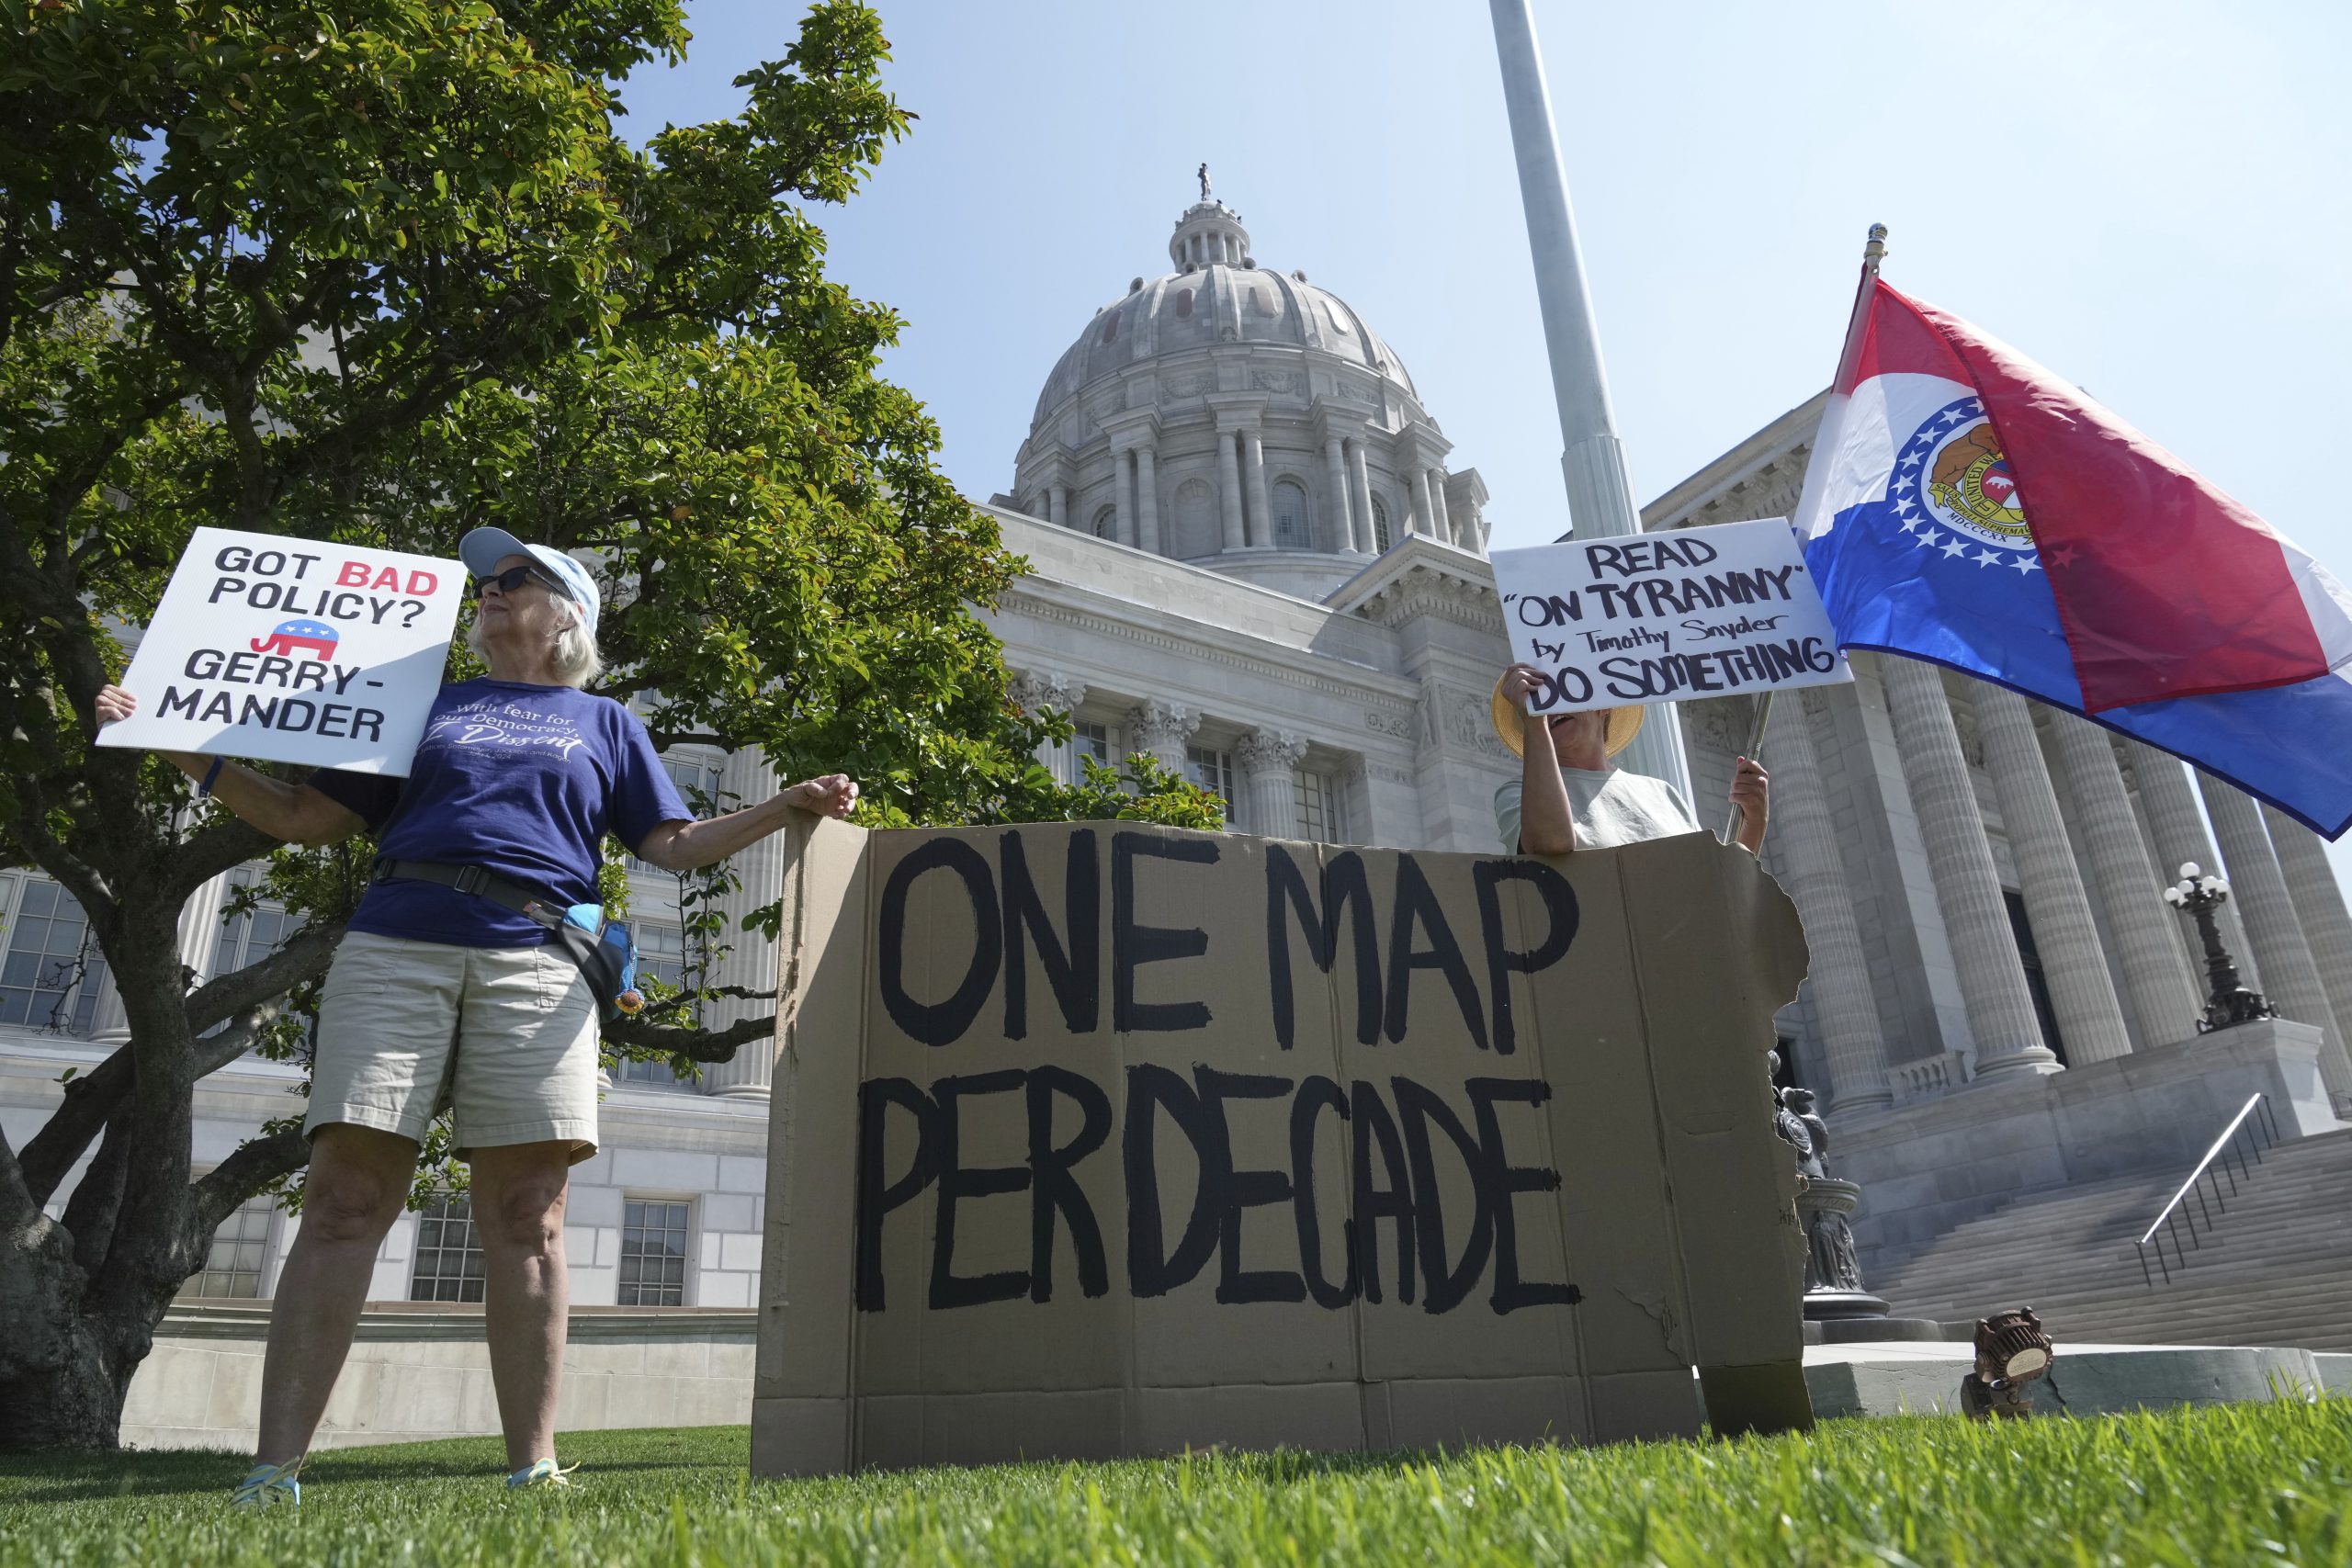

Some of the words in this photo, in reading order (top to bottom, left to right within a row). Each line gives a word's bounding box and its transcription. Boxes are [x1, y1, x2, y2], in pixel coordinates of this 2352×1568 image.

[1966, 467, 1984, 503] UNITED
[1935, 483, 1959, 499] SALUS
[1951, 499, 1977, 523] POPULI
[1976, 519, 2025, 535] SUPREMA
[1947, 512, 2009, 543] MDCCCXX
[215, 546, 321, 580] GOT
[334, 560, 438, 596] BAD
[1585, 537, 1717, 580] READ
[208, 577, 426, 628] POLICY?
[1503, 590, 1583, 627] "ON
[1532, 637, 1566, 663] by
[1576, 626, 1670, 653] Timothy
[1679, 615, 1790, 642] Snyder
[184, 649, 383, 695] GERRY-
[1529, 667, 1593, 711] DO
[1599, 637, 1835, 699] SOMETHING
[155, 685, 385, 742] MANDER
[457, 704, 498, 713] With
[503, 704, 542, 721] fear
[546, 713, 574, 725] for
[470, 714, 580, 738] Democracy,
[416, 721, 461, 750] I
[454, 724, 593, 760] Dissent
[878, 828, 1222, 1047] ONE
[1264, 843, 1581, 1055] MAP
[855, 1065, 1114, 1314] PER
[1125, 1062, 1584, 1316] DECADE
